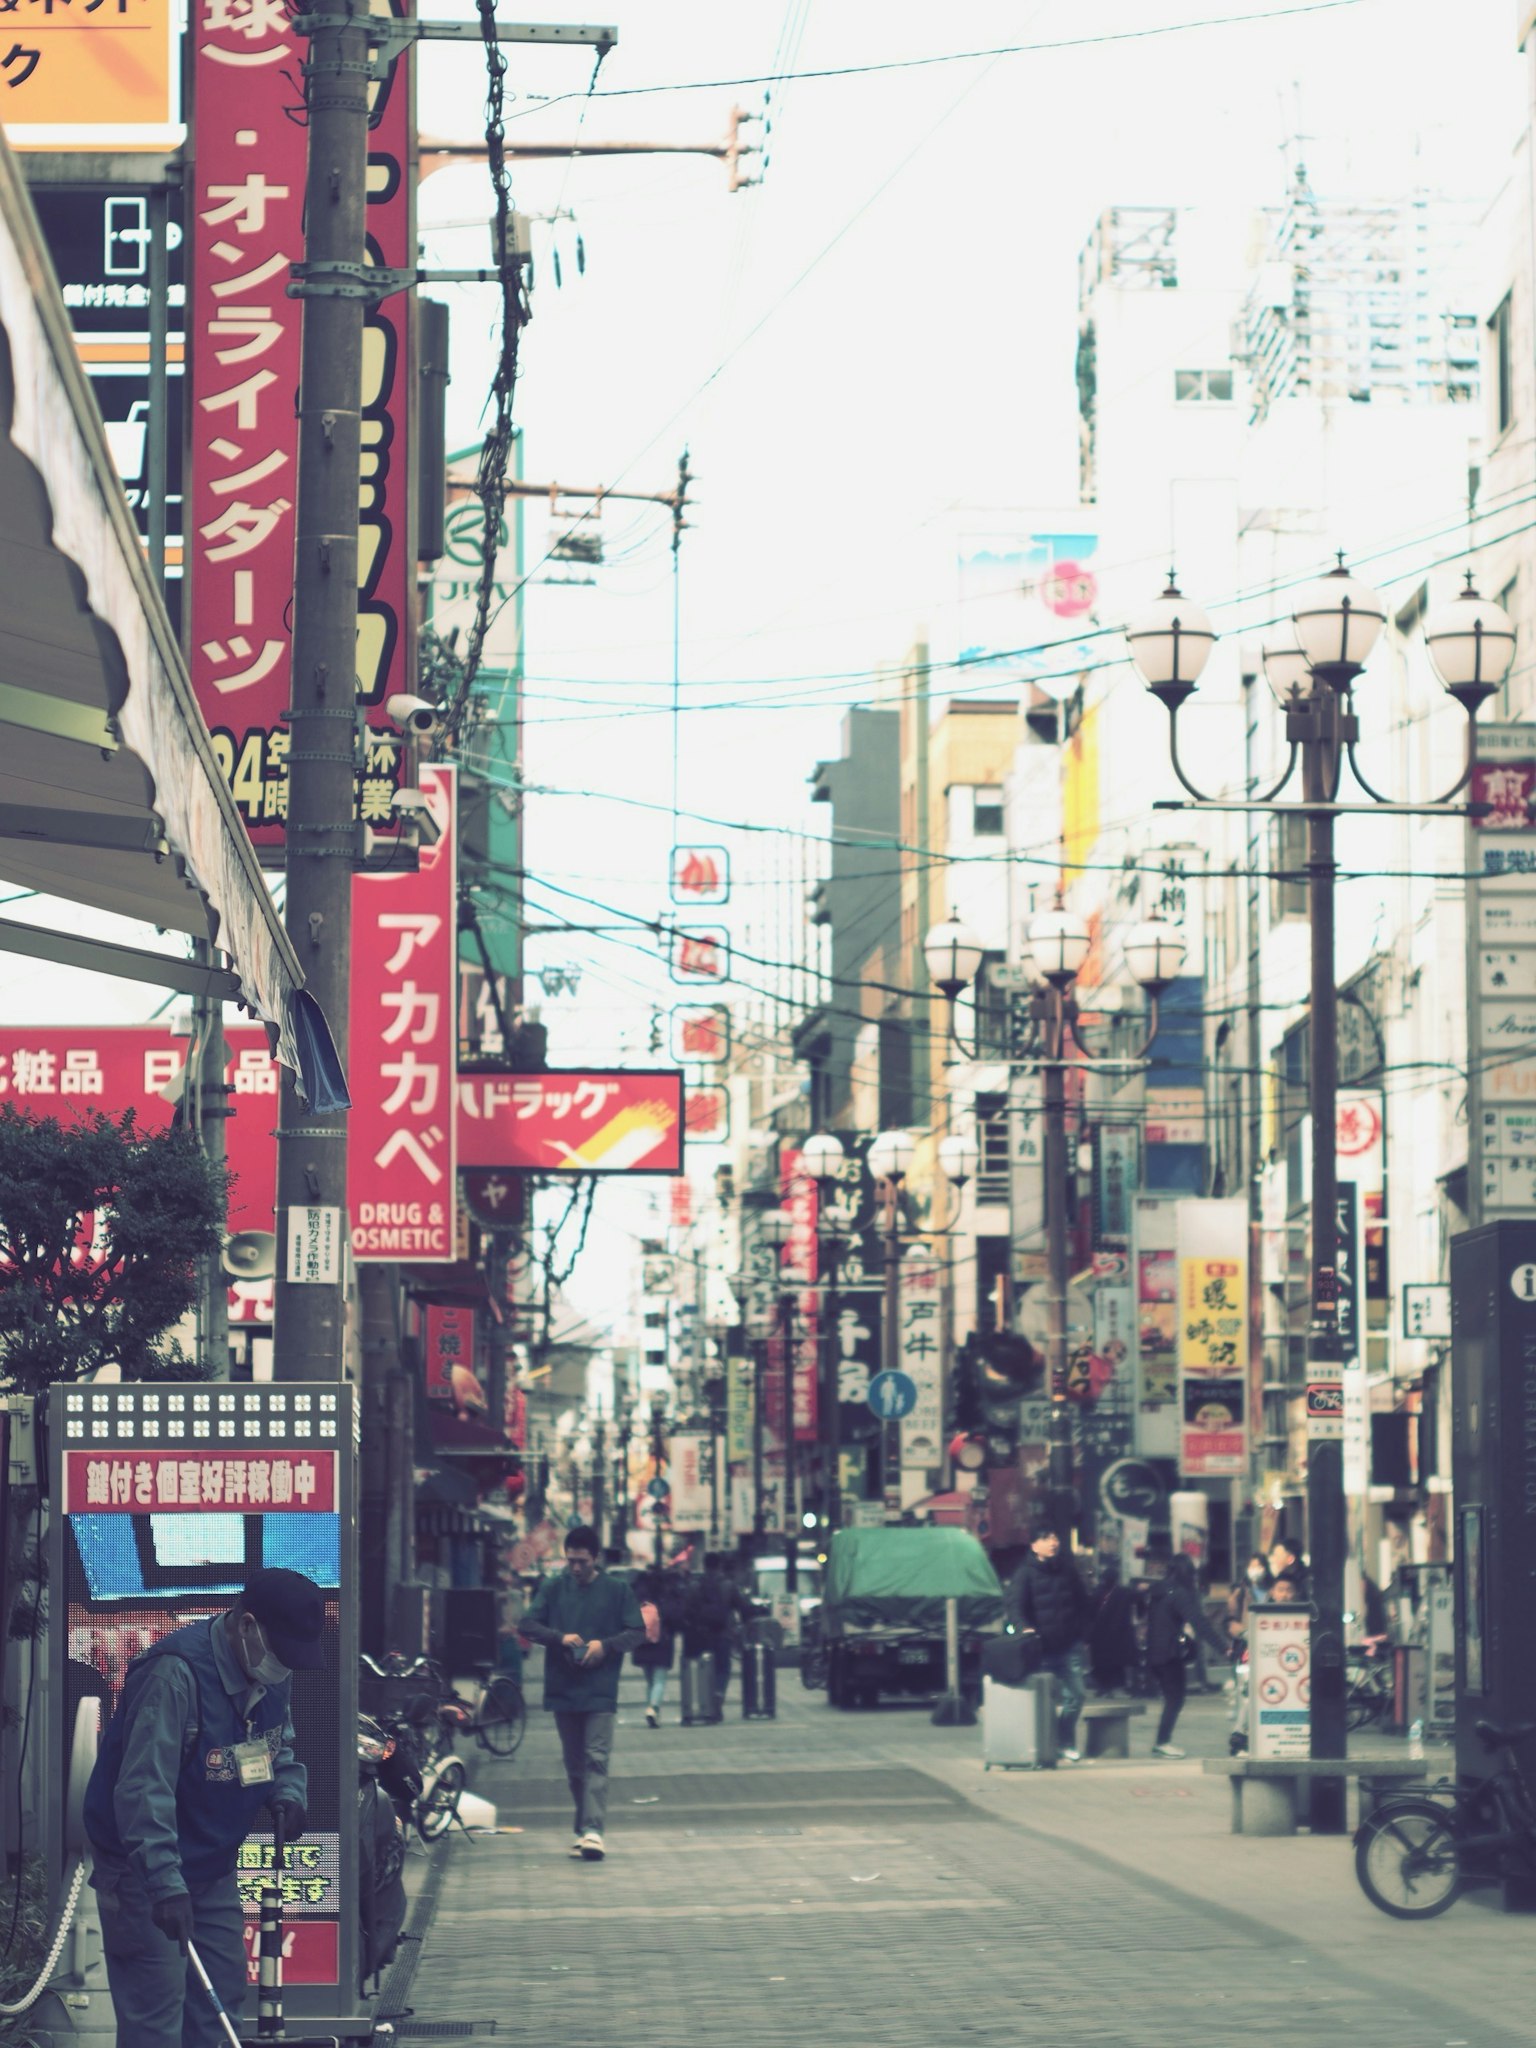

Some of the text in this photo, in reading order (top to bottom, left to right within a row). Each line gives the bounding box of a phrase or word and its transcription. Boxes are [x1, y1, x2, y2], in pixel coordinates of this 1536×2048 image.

[374, 914, 442, 1185] アカカベ
[144, 1050, 278, 1095] 日品
[359, 1203, 445, 1225] DRUG &
[352, 1228, 445, 1250] OSMETIC
[87, 1461, 315, 1504] 鍵付き個室好評稼働中
